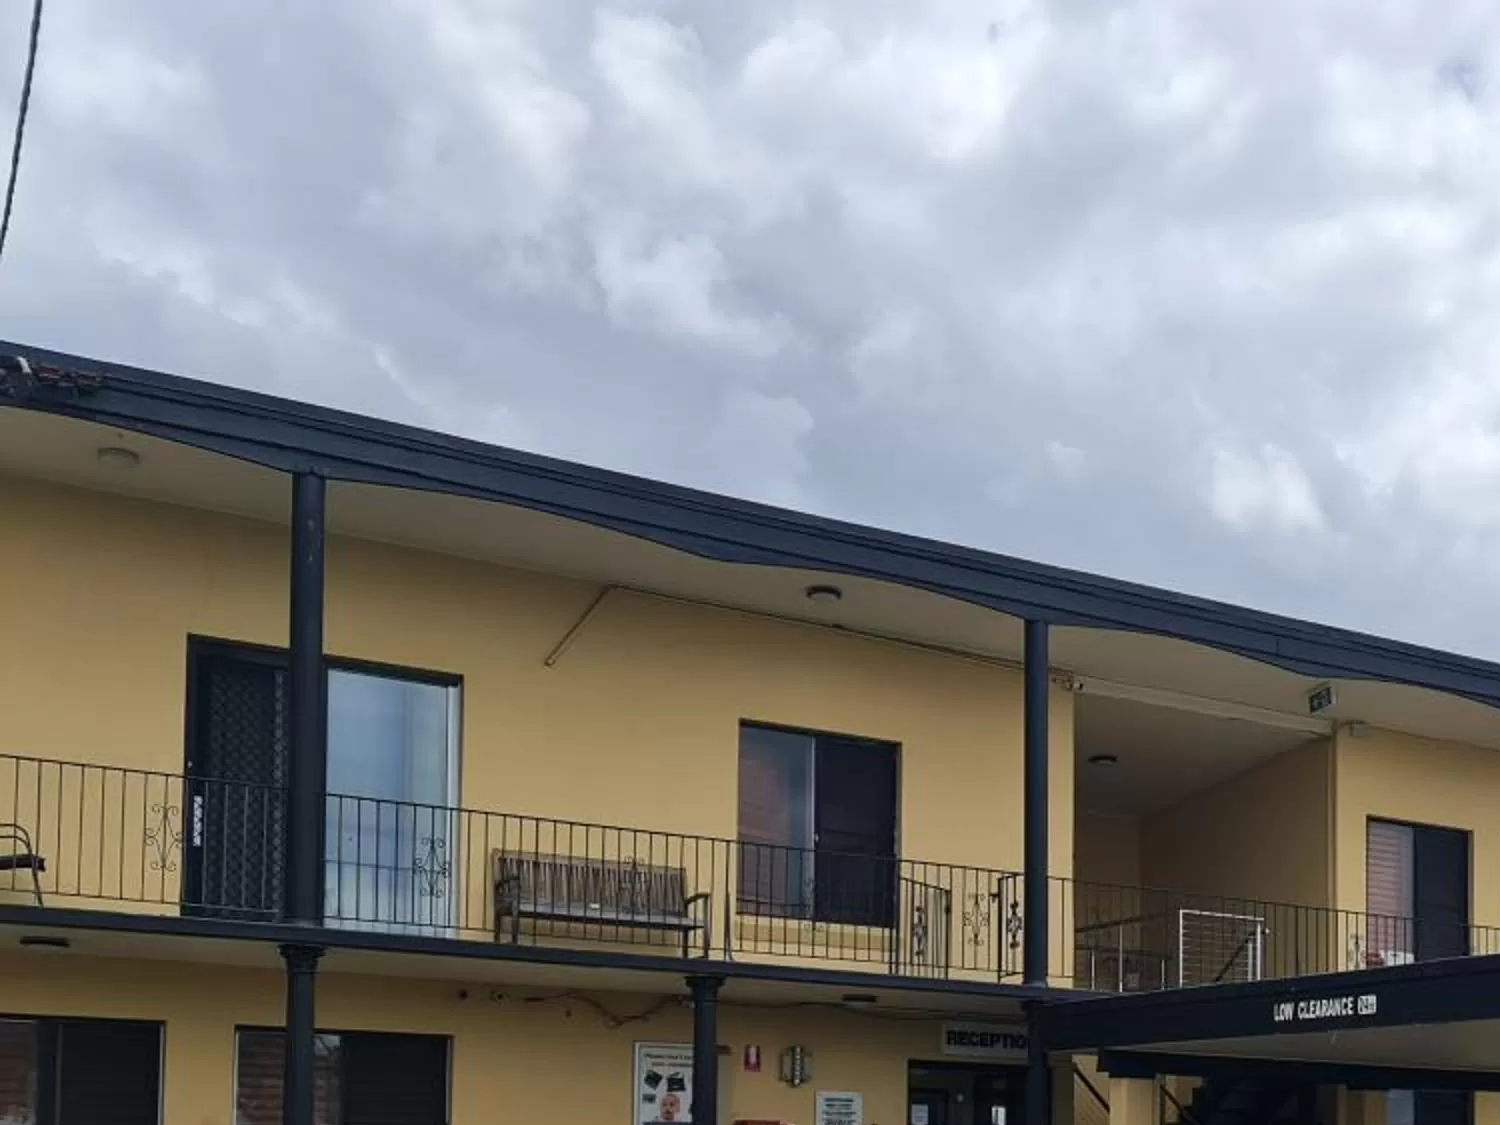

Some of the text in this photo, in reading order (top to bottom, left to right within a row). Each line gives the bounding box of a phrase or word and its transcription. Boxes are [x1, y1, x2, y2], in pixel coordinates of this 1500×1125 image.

[1274, 1002, 1294, 1021] LOW
[1298, 997, 1354, 1019] CLEARANCE
[946, 1030, 1027, 1049] RECEPTIO
